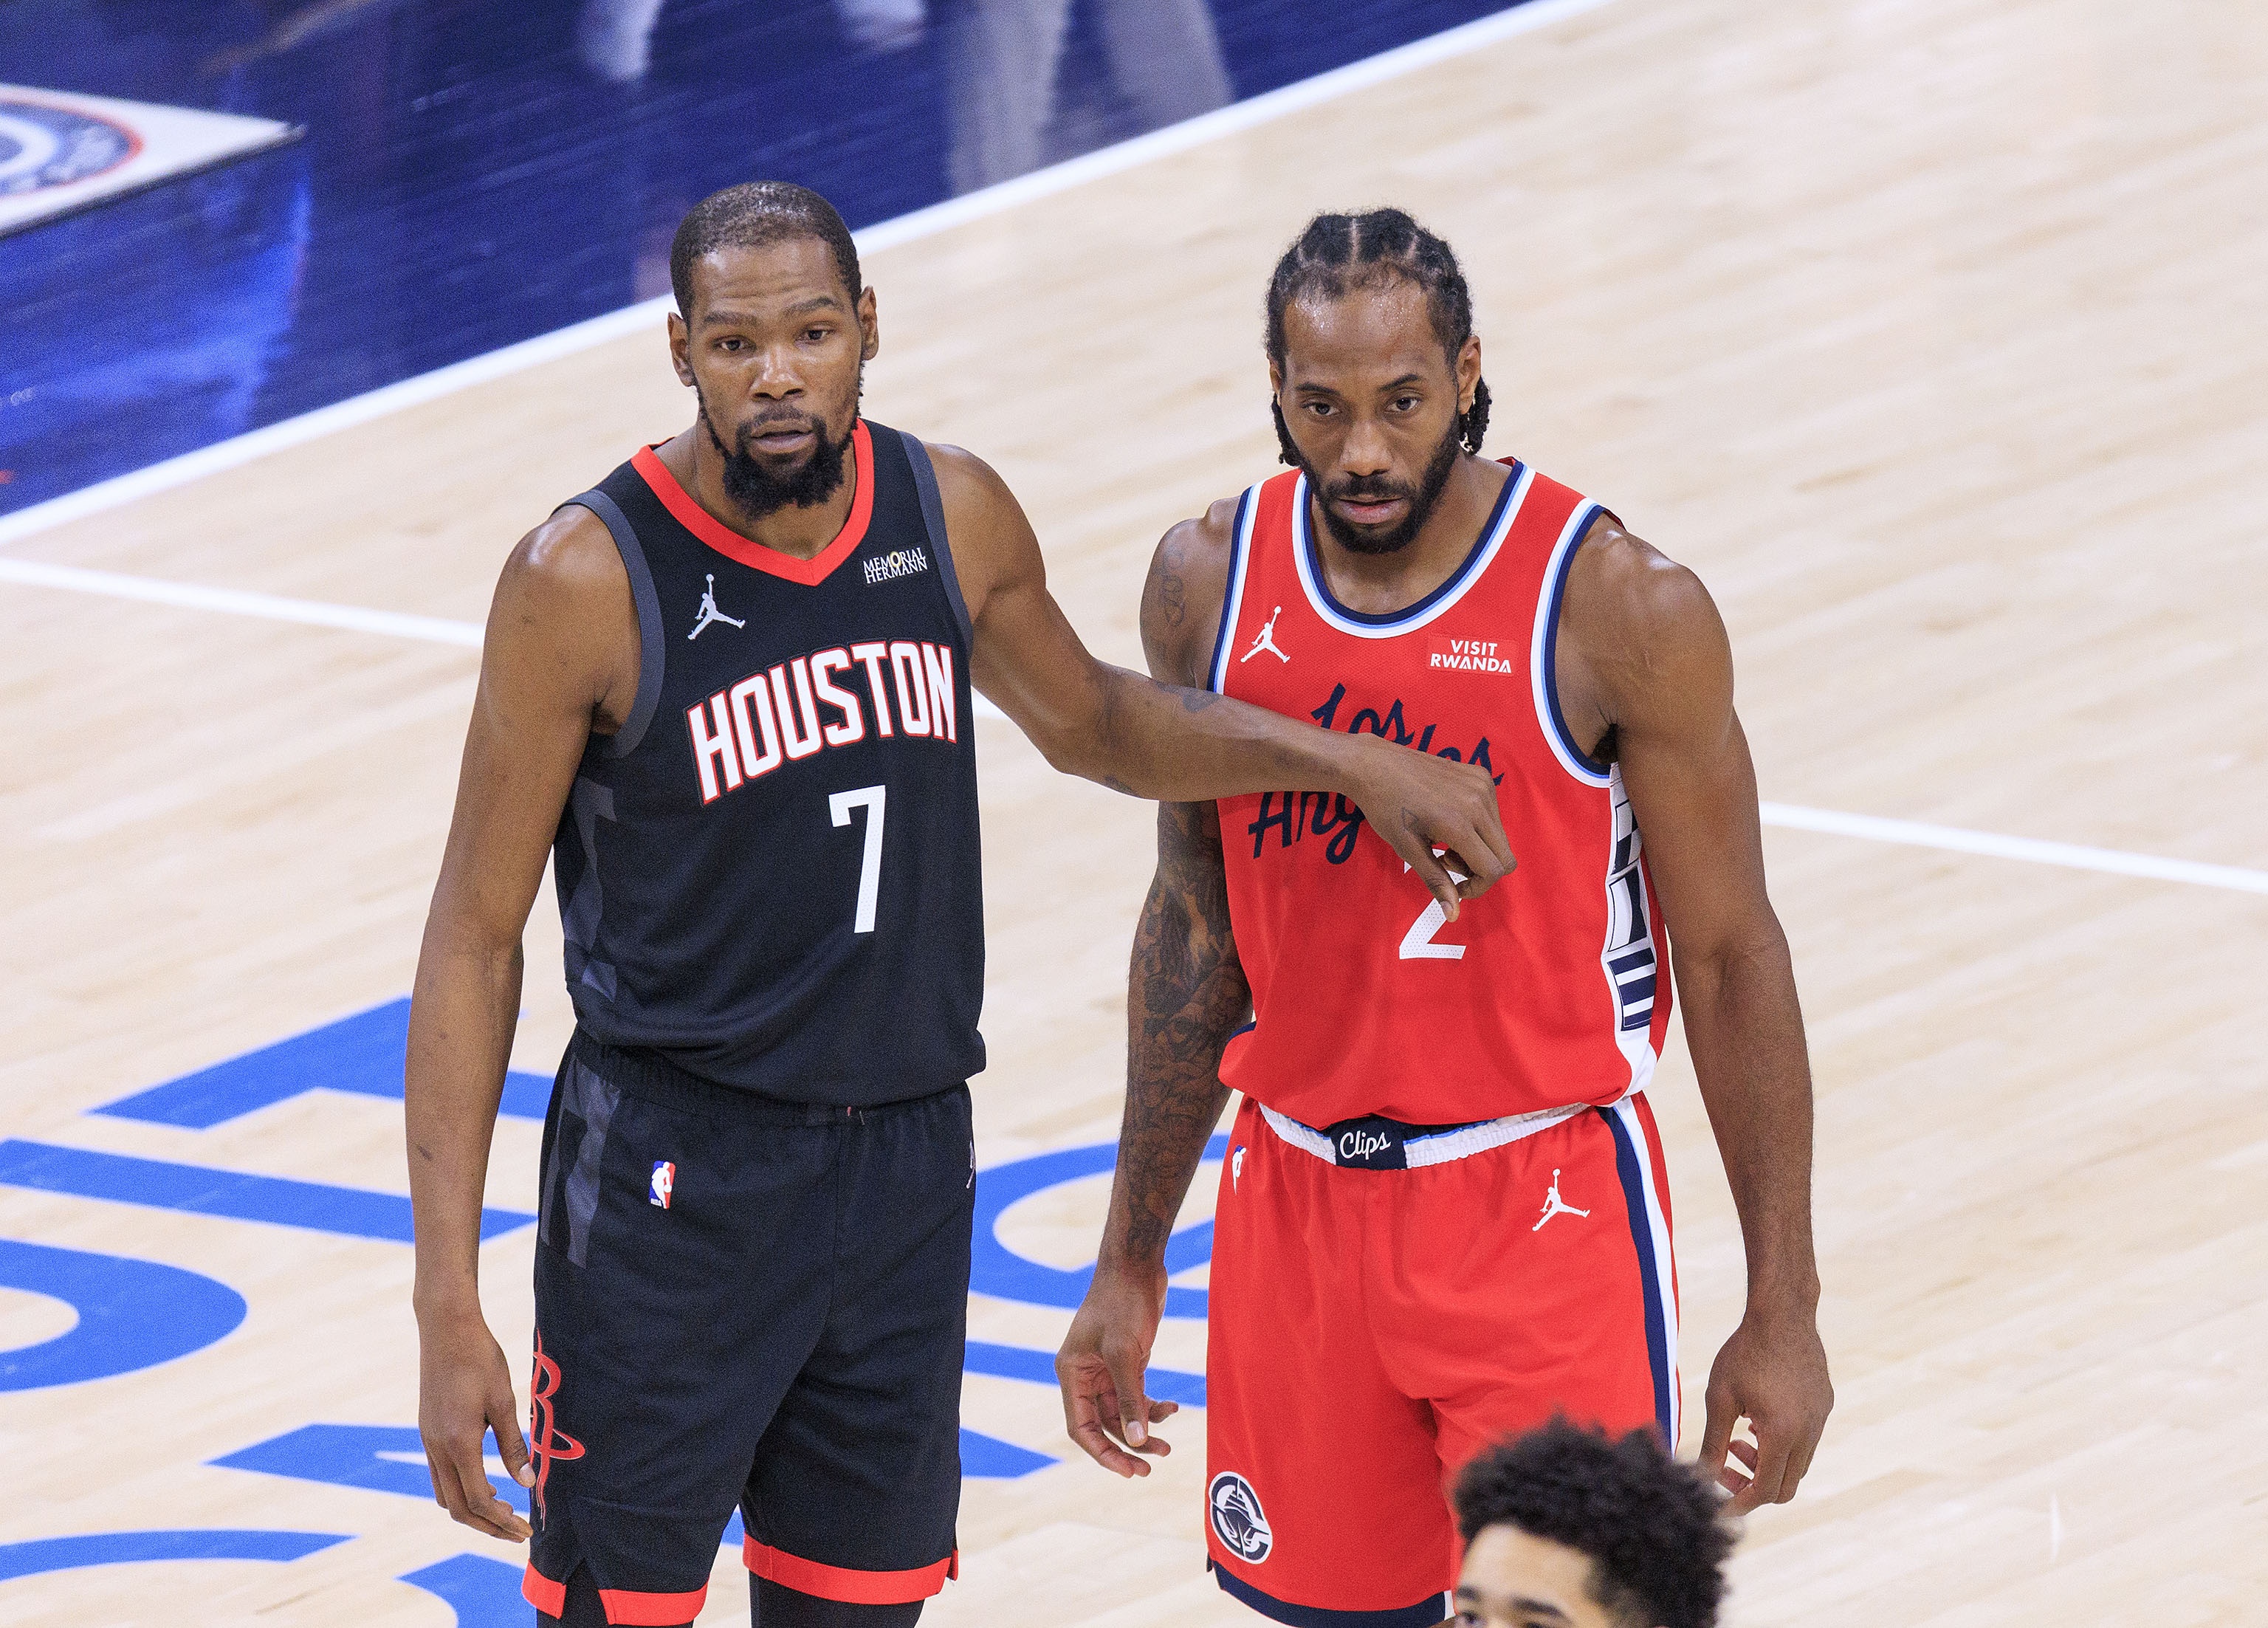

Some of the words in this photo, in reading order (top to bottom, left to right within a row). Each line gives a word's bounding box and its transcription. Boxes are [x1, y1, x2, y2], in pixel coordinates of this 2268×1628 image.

[863, 547, 926, 573] MEMORIAL
[865, 557, 928, 584] HERMANN
[1451, 639, 1498, 656] VISIT
[1430, 653, 1512, 673] RWANDA
[687, 640, 957, 805] HOUSTON
[828, 784, 886, 934] 7
[1339, 1130, 1392, 1160] Clips
